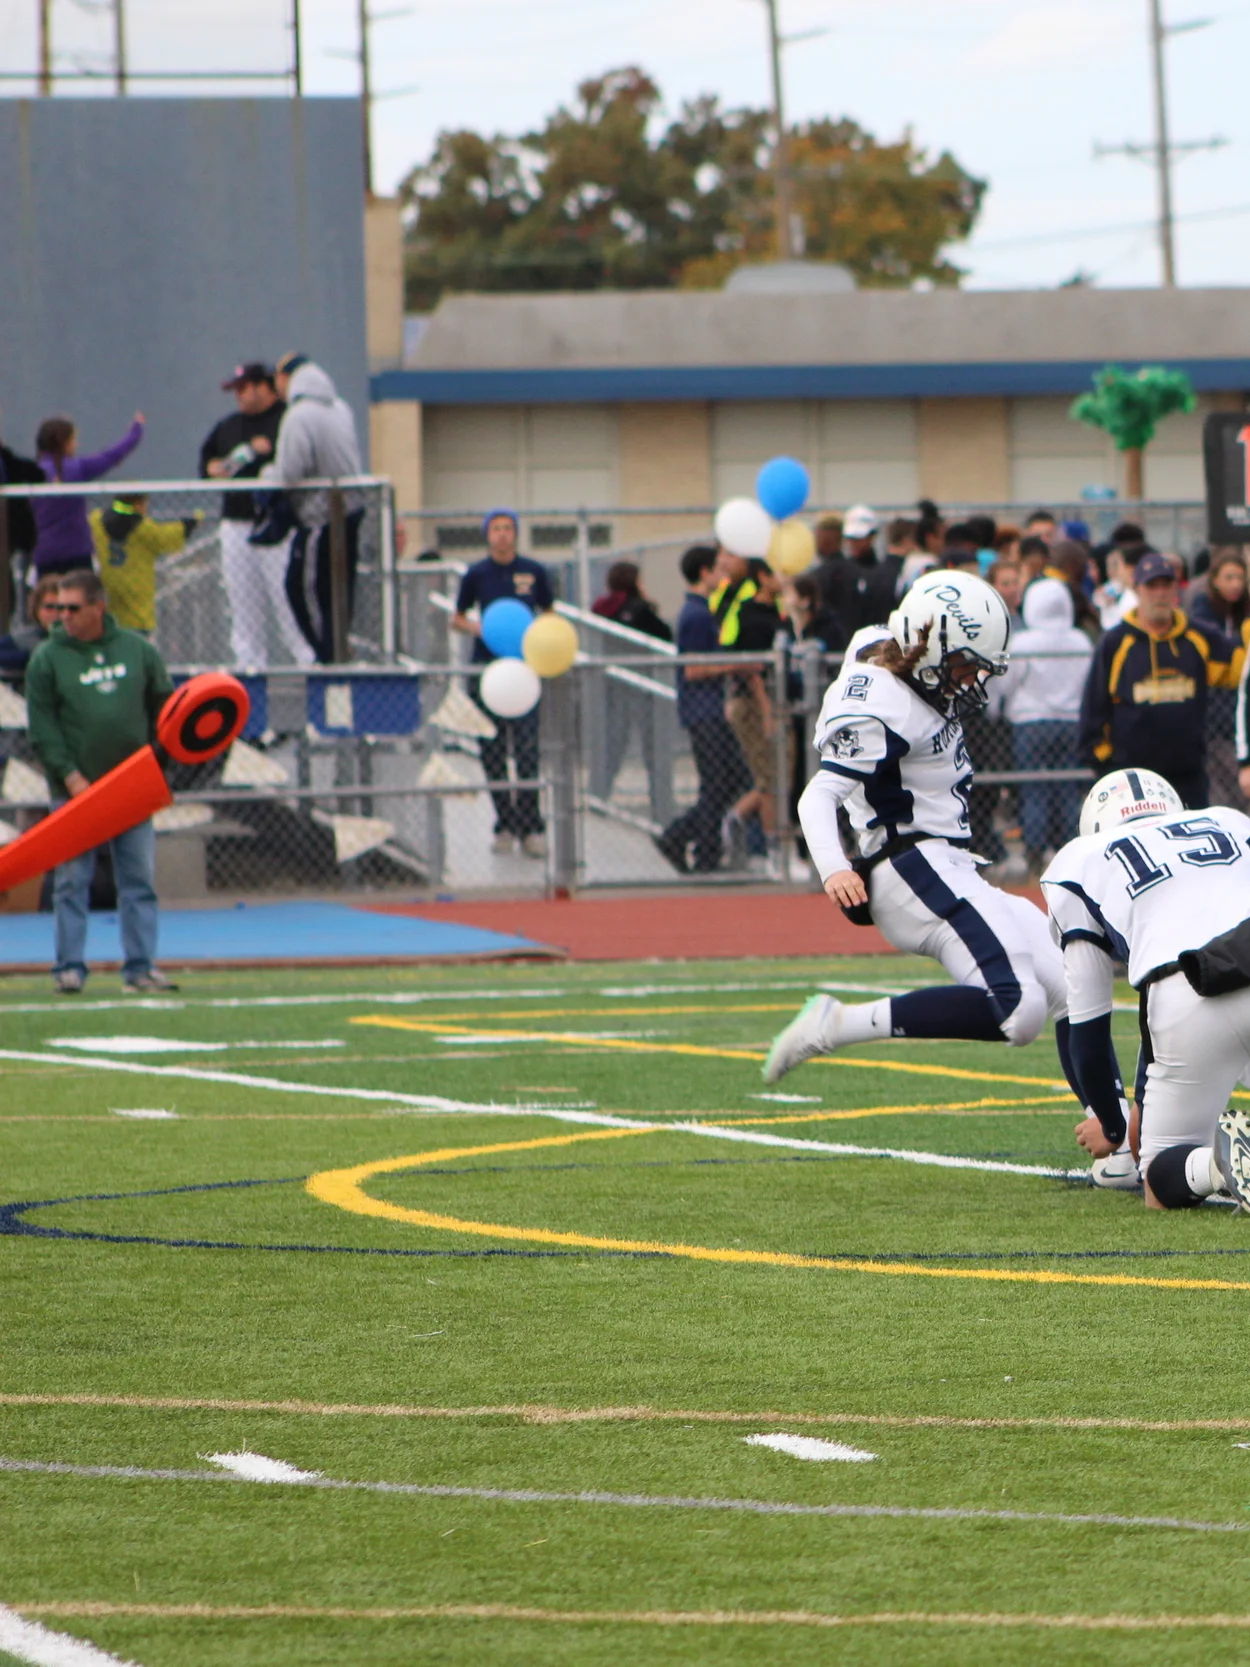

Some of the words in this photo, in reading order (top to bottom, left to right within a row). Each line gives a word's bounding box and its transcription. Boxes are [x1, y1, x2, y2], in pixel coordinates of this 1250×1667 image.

[935, 585, 983, 641] Devils
[841, 673, 875, 702] 2
[1120, 800, 1167, 818] Riddell
[1104, 816, 1242, 900] 15
